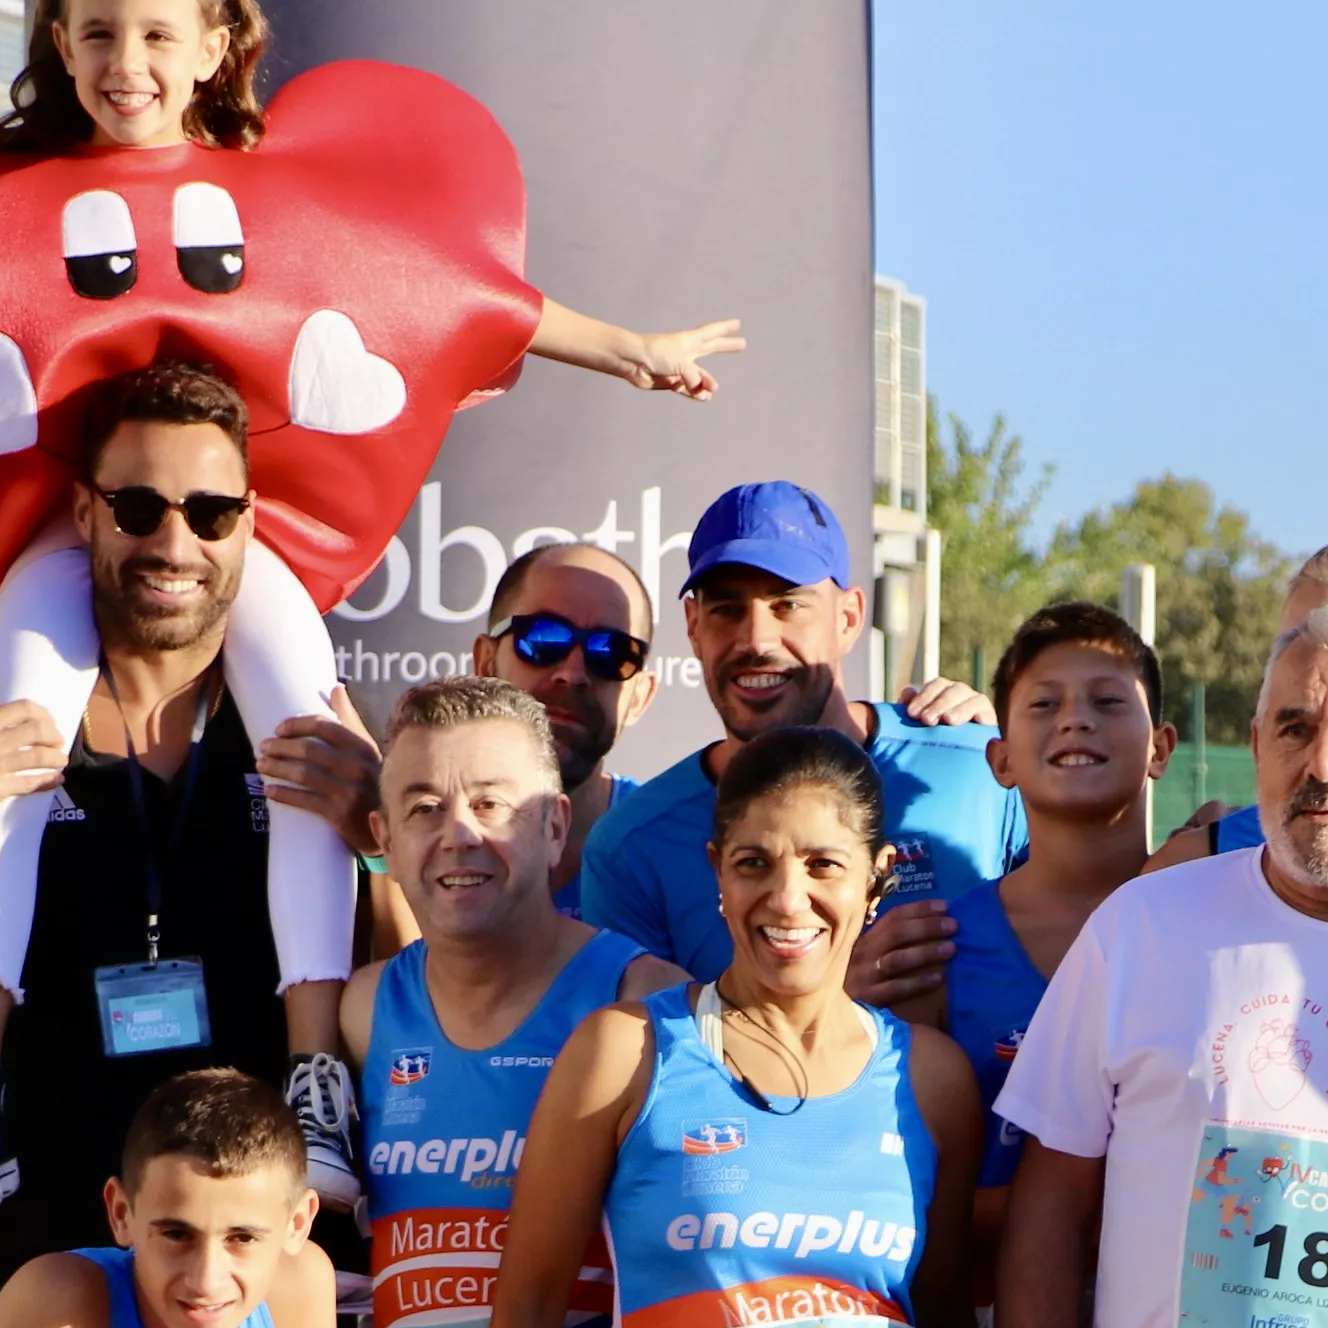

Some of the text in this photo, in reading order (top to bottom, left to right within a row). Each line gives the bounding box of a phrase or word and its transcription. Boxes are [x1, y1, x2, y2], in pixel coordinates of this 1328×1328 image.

[1240, 994, 1290, 1015] CUIDA
[1302, 998, 1322, 1015] TU
[1290, 1162, 1313, 1184] IV
[666, 1210, 916, 1262] enerplus
[1221, 1283, 1269, 1299] EUGENIO
[1273, 1292, 1313, 1306] AROCA
[1278, 1313, 1310, 1326] GRUPO
